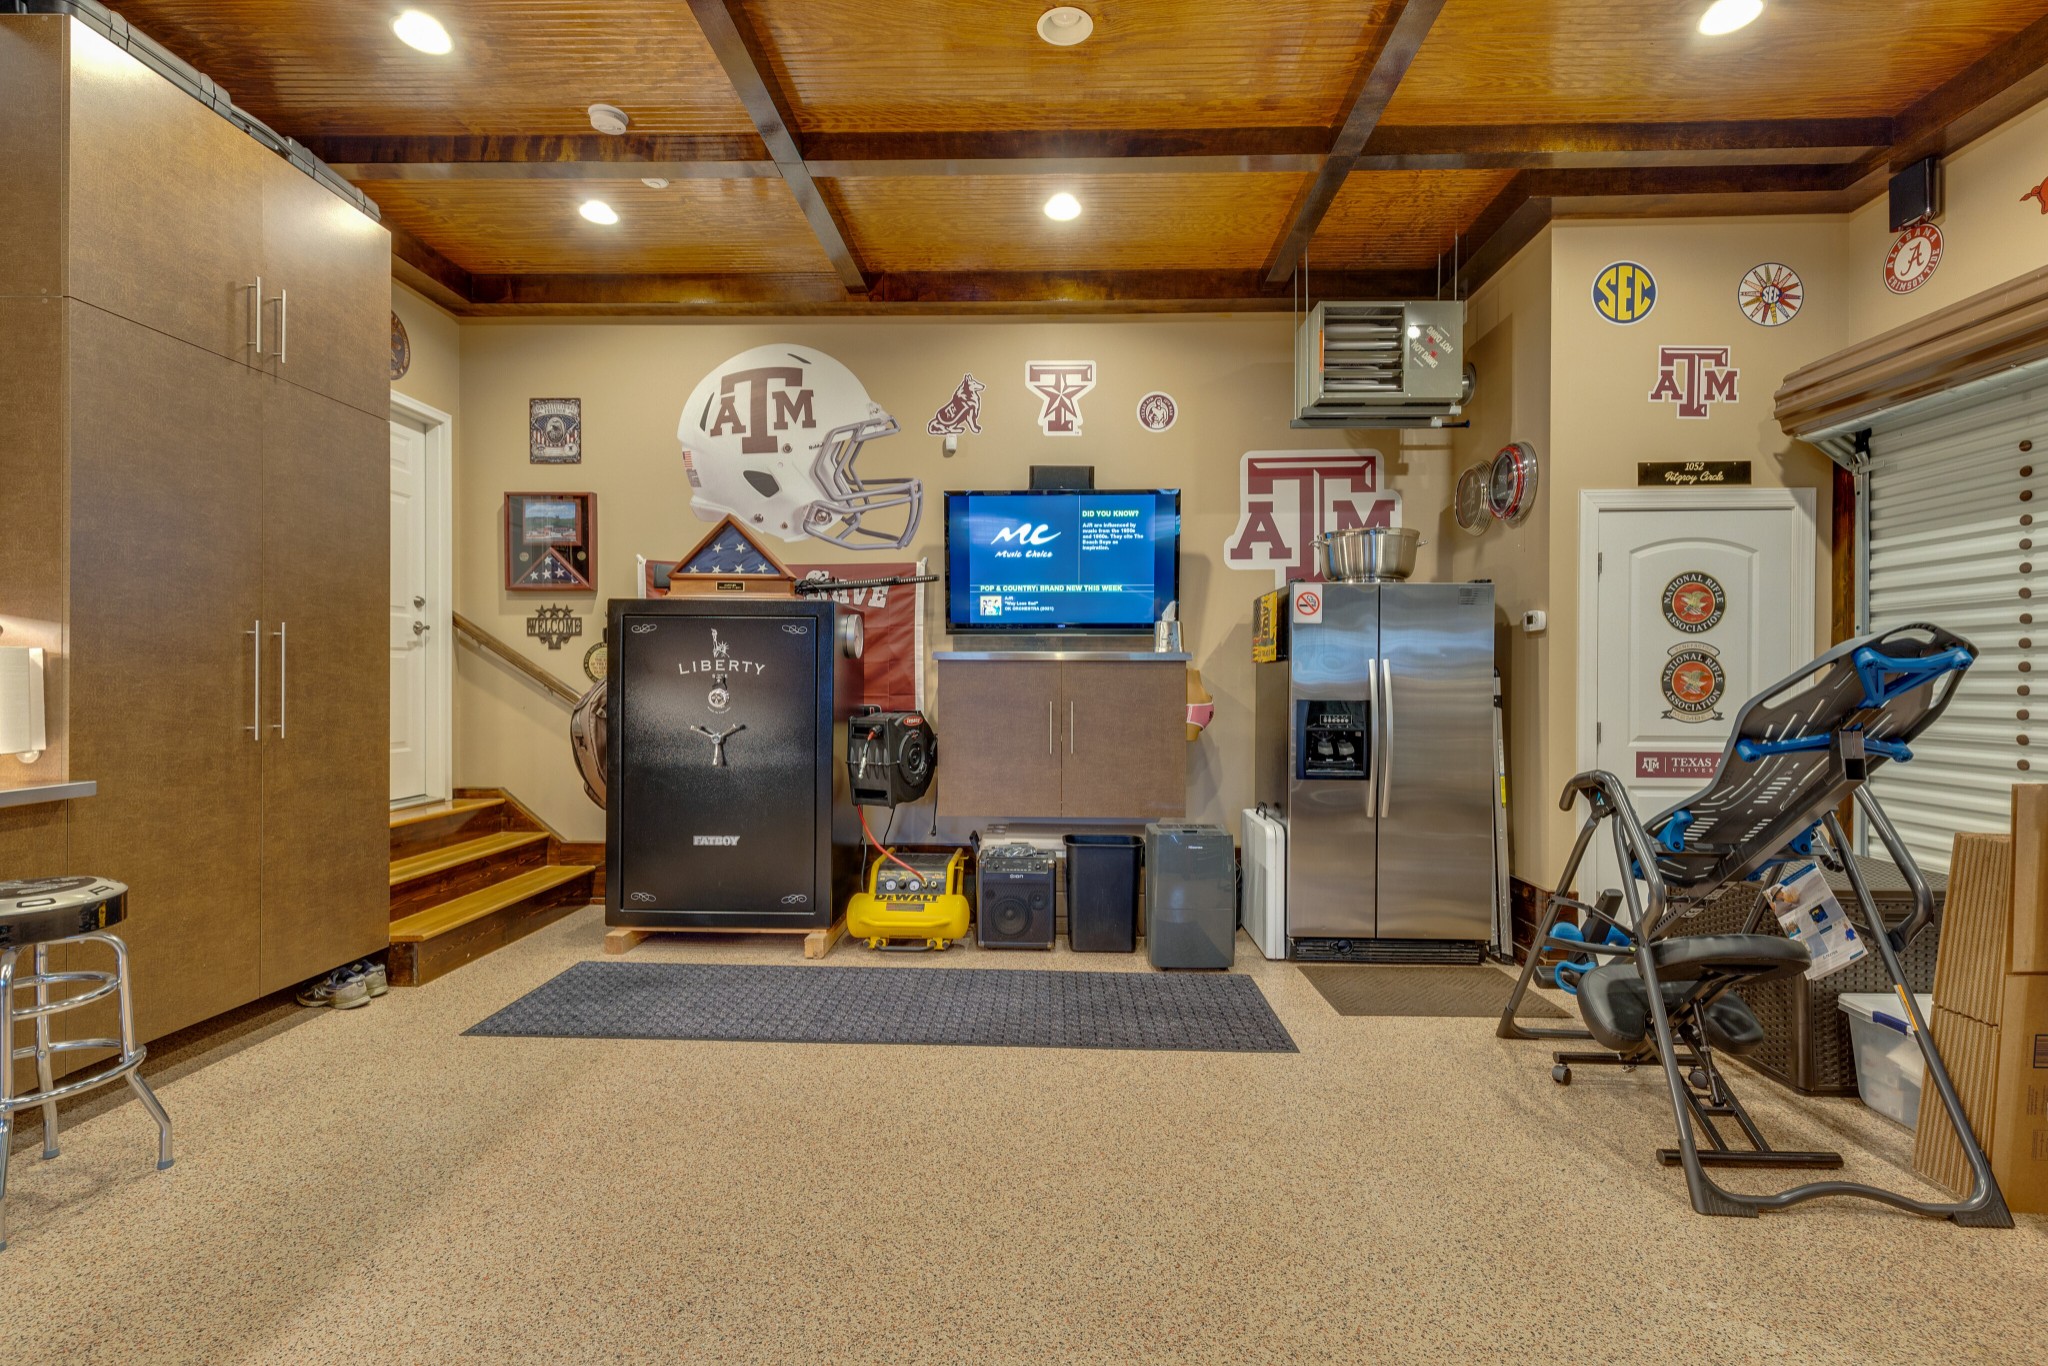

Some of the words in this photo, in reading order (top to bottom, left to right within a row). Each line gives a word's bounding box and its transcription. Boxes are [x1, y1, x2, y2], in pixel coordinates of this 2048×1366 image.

[1901, 241, 1925, 277] A
[1888, 275, 1925, 291] CRIMSON
[1923, 247, 1940, 274] TIDE
[1597, 265, 1652, 321] SEC
[1685, 462, 1705, 471] 1052
[1700, 471, 1724, 482] Circle
[990, 523, 1062, 546] MC
[995, 550, 1022, 558] Music
[1025, 549, 1053, 558] Choice
[1664, 573, 1703, 603] NATIONAL
[1706, 578, 1724, 603] RIFLE
[527, 618, 581, 635] WELCOME
[1665, 609, 1722, 633] ASSOCIATION
[678, 659, 766, 675] LIBERTY
[1664, 653, 1703, 682] NATIONAL
[1705, 658, 1723, 683] RIFLE
[1665, 690, 1721, 711] ASSOCIATION
[1671, 757, 1712, 767] TEXAS
[692, 835, 741, 846] FATBOY
[874, 894, 939, 902] DEWALT
